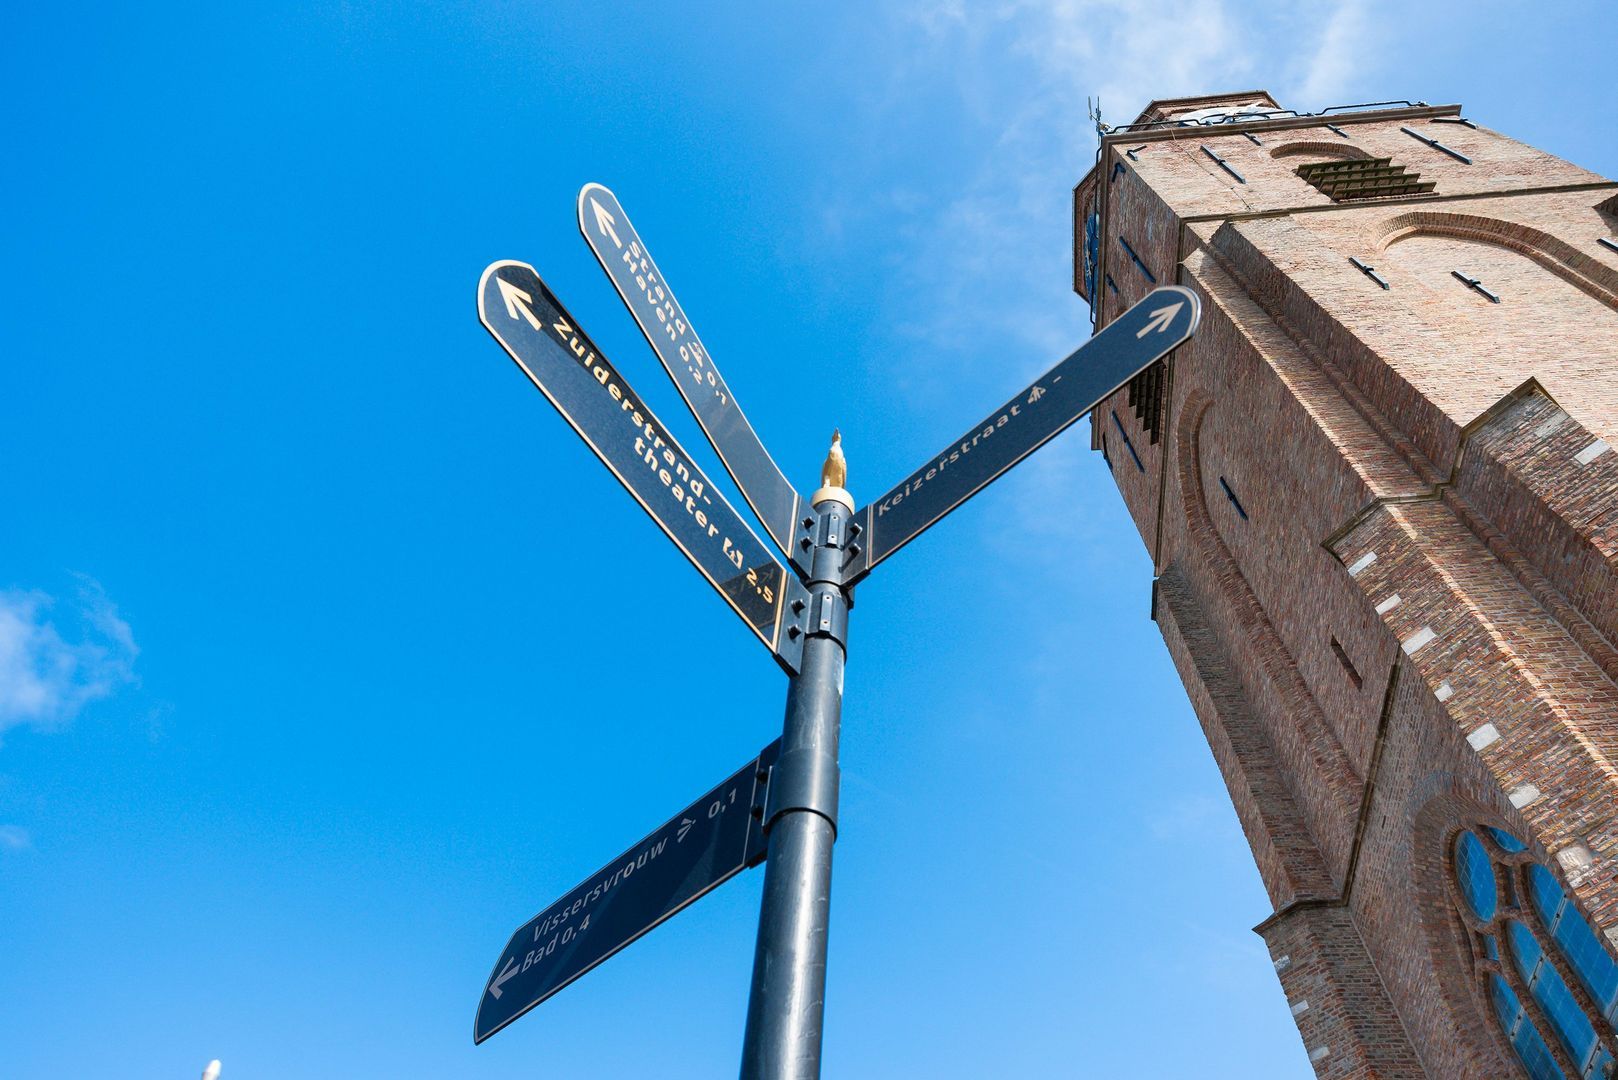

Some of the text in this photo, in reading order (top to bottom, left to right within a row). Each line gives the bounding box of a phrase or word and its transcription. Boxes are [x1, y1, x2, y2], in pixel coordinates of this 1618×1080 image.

[622, 250, 676, 342] Haven
[629, 240, 686, 336] Strand
[552, 316, 712, 505] Zuiderstrand-
[878, 403, 1021, 517] Keizerstraat
[634, 436, 719, 537] theater
[533, 788, 737, 942] Vissersvrouw 0,1
[521, 914, 591, 974] Bad 0,4
